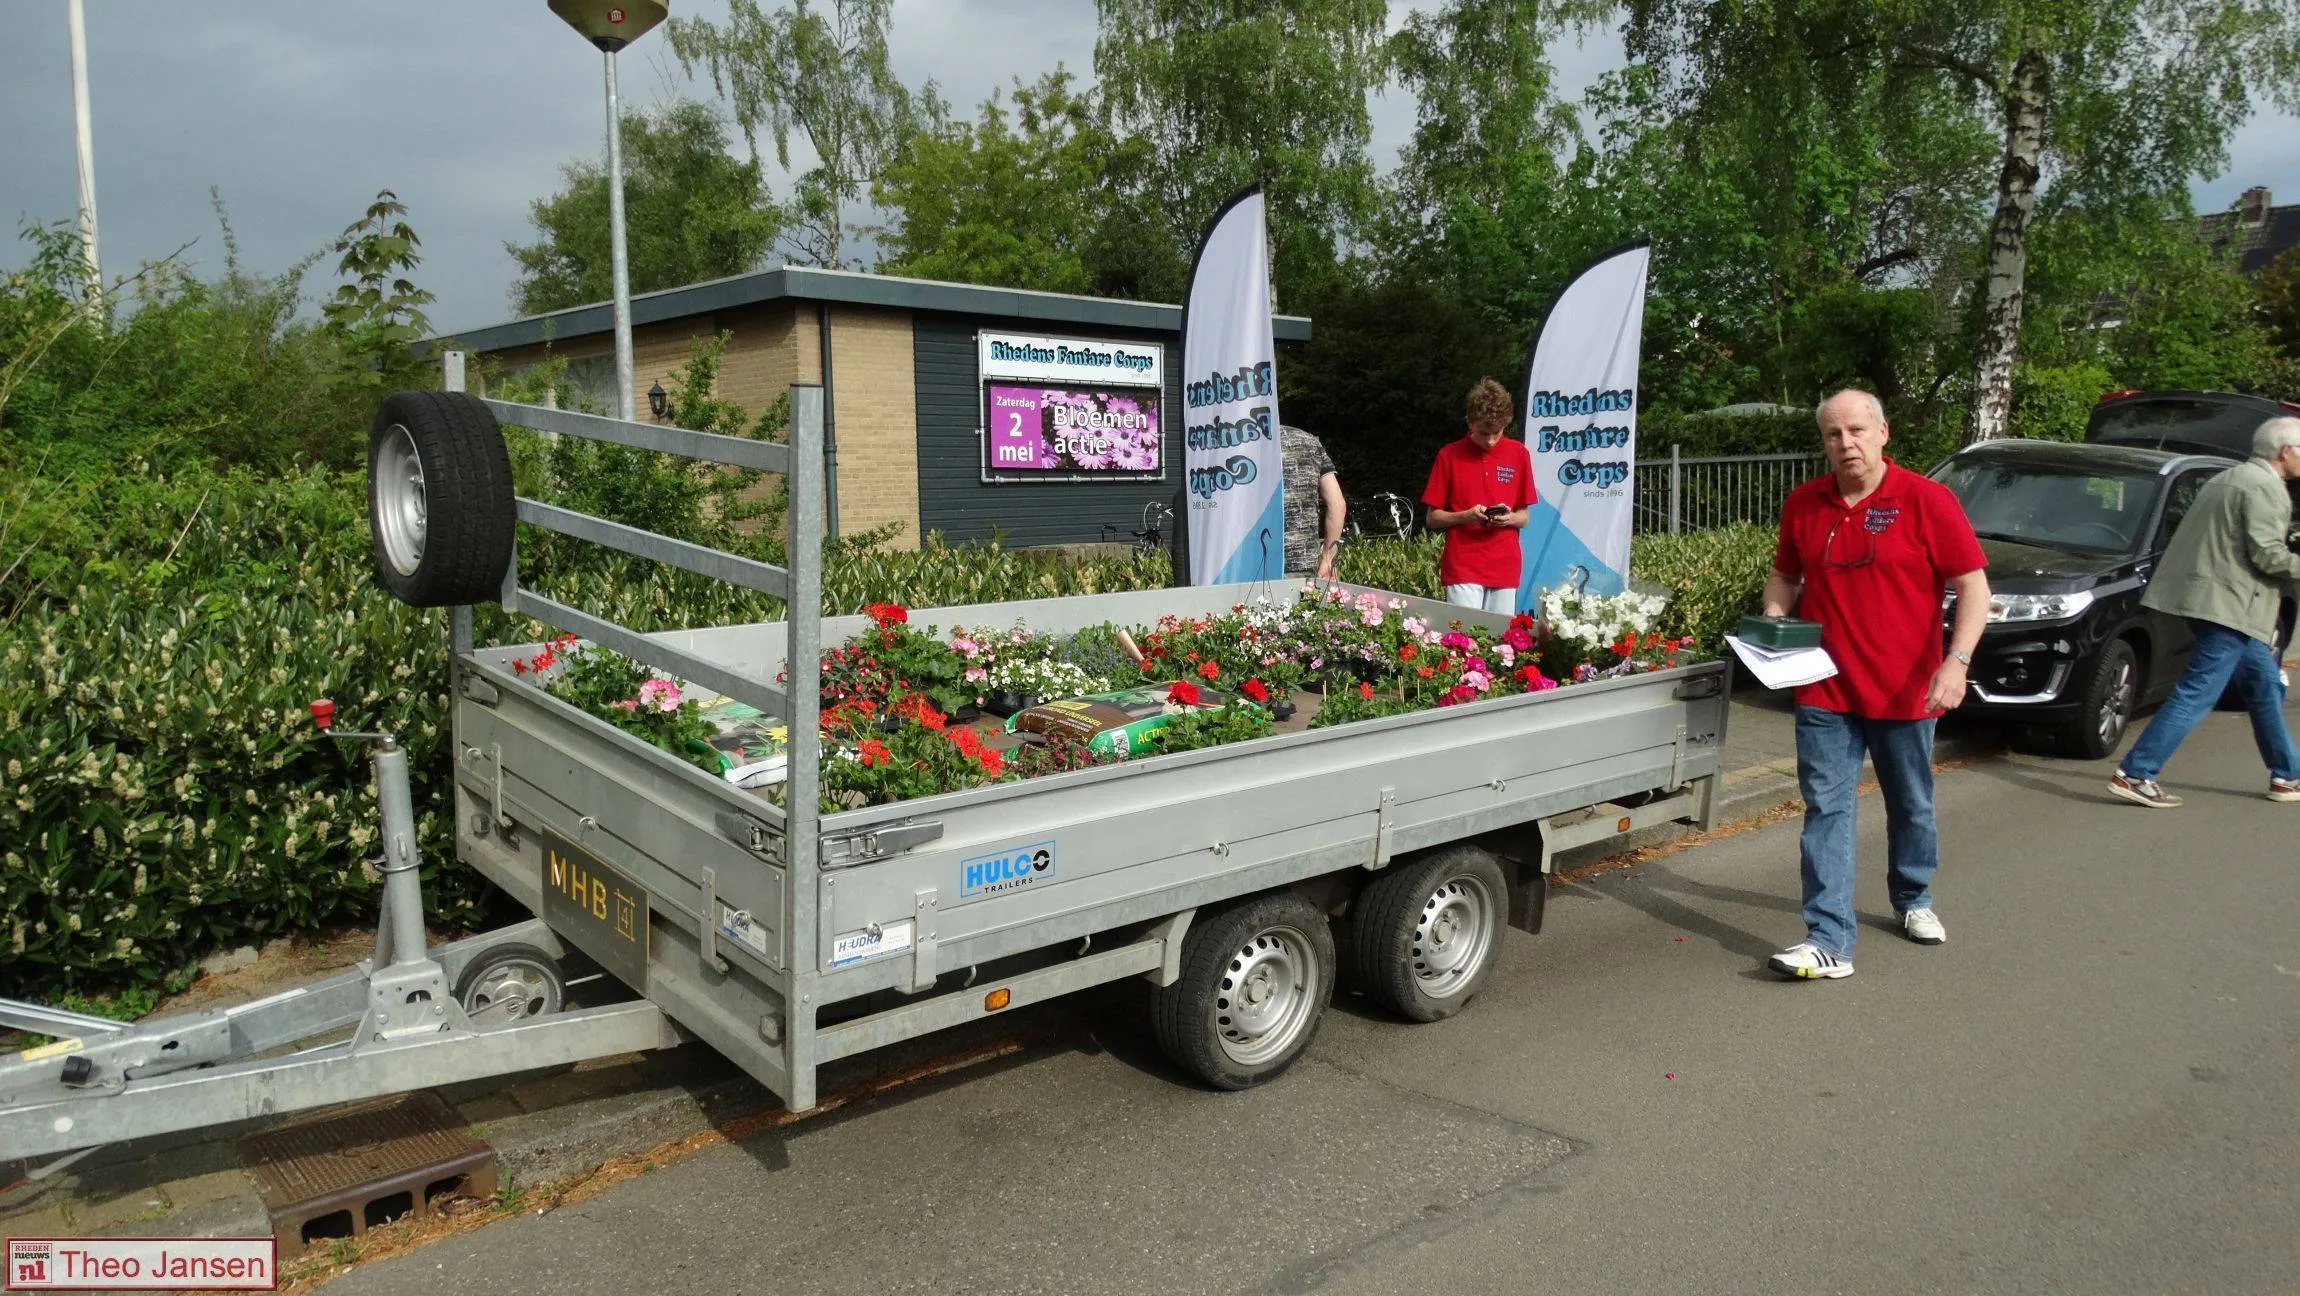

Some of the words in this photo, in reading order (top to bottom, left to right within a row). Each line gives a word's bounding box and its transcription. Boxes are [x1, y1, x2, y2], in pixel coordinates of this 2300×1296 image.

[991, 341, 1054, 363] Rhedens
[1057, 346, 1111, 367] Fanfare
[1113, 350, 1153, 372] Corps
[996, 396, 1036, 410] Zaterdag
[1531, 387, 1633, 418] Rhedns
[1009, 412, 1023, 437] 2
[1053, 405, 1147, 429] Bloemen
[1055, 433, 1108, 454] actie
[1537, 423, 1630, 453] Fanare
[999, 441, 1034, 462] mei
[1583, 490, 1605, 498] sinds
[966, 849, 1050, 889] HULCO
[550, 849, 607, 920] MHB
[984, 877, 1033, 893] TRAILERS
